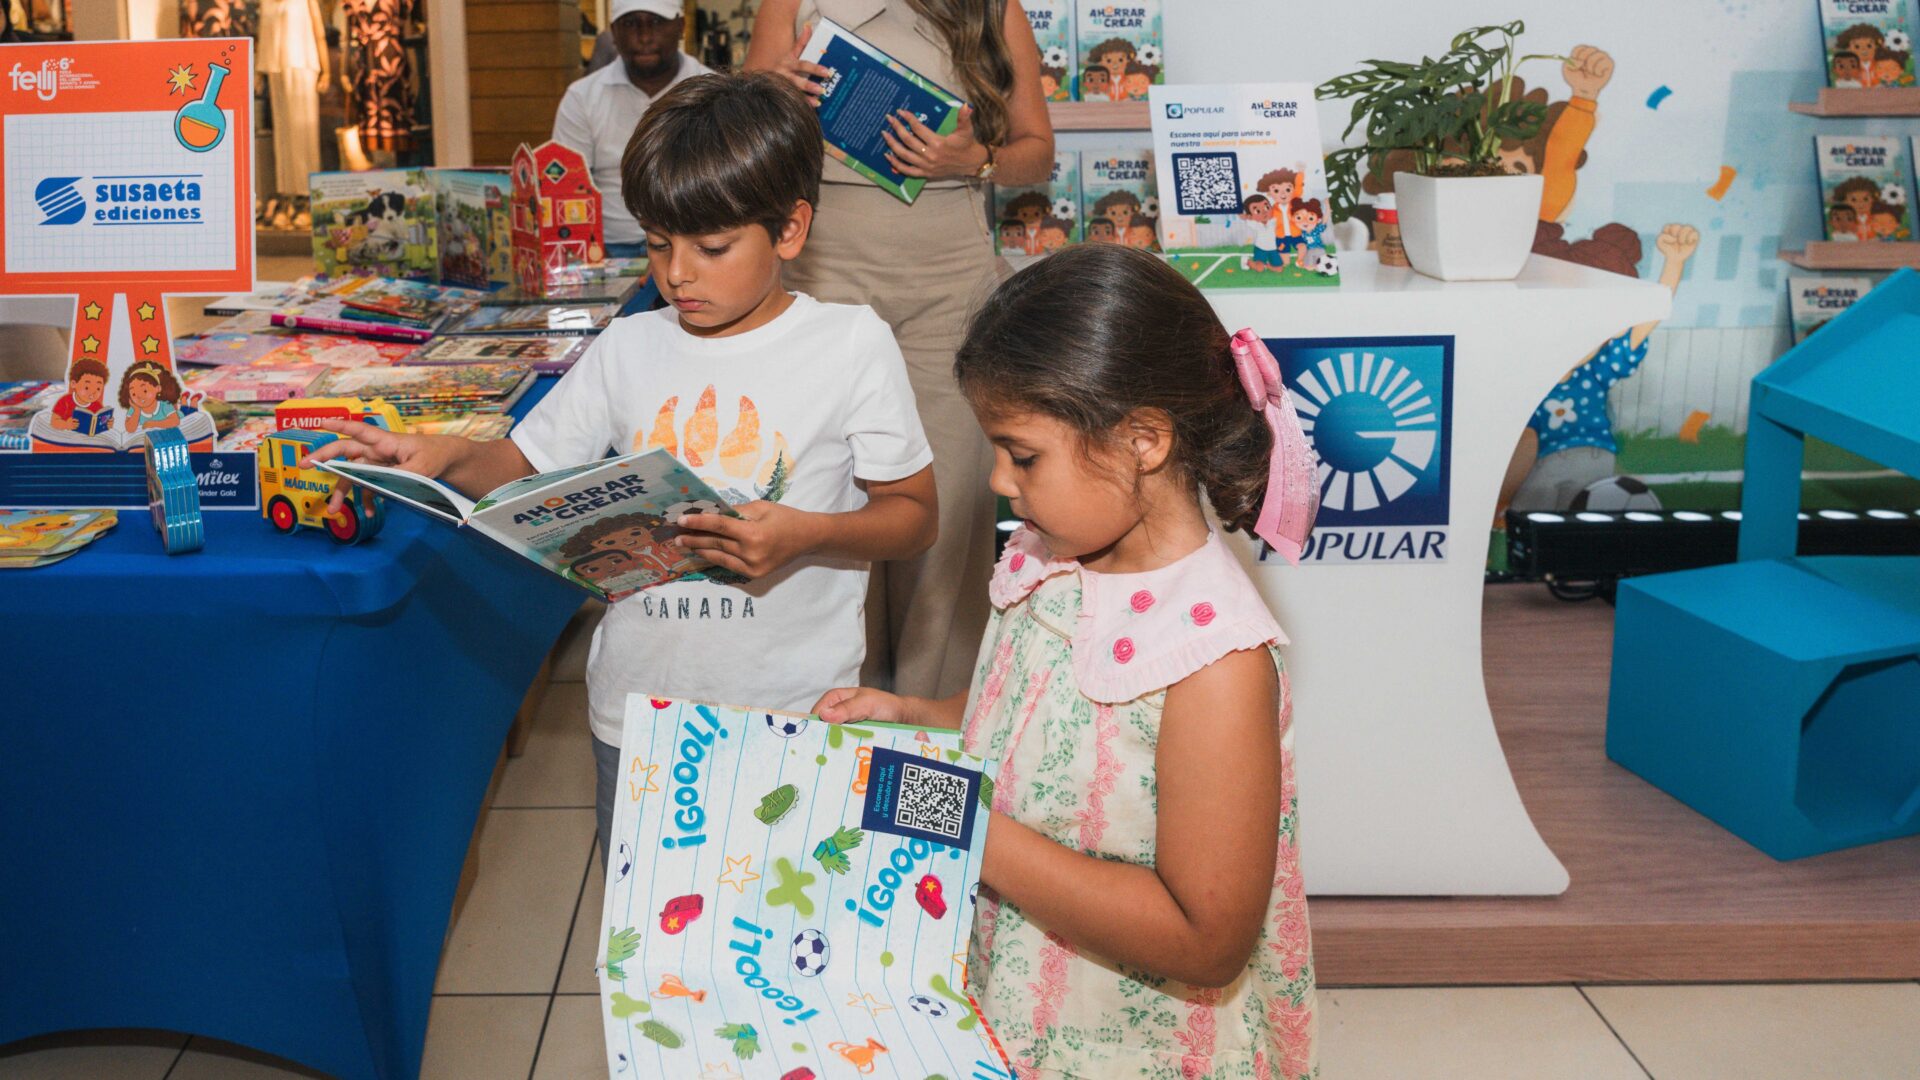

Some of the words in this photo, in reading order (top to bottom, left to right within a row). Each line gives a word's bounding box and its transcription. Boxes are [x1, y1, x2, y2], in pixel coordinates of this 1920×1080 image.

[1089, 5, 1146, 18] AHORRAR
[1848, 4, 1888, 14] CREAR
[1104, 18, 1143, 28] CREAR
[1184, 106, 1225, 114] POPULAR
[1251, 100, 1298, 110] AHORRAR
[1263, 110, 1296, 118] CREAR
[1170, 131, 1201, 139] Escanea
[1203, 130, 1220, 139] aquí
[1221, 131, 1239, 139] para
[1830, 144, 1887, 156] AHORRAR
[1094, 158, 1149, 170] AHORRAR
[1846, 156, 1885, 167] CREAR
[1108, 170, 1146, 180] CREAR
[96, 179, 200, 203] susaeta
[95, 205, 201, 220] ediciones
[1803, 286, 1858, 298] AHORRAR
[282, 416, 345, 429] CAMIO
[196, 471, 240, 486] Milex
[285, 476, 330, 494] MÁQUINAS
[220, 489, 237, 497] Gold
[513, 474, 646, 525] AHORRAR
[530, 514, 554, 527] ES
[556, 485, 649, 520] CREAR
[1259, 531, 1447, 561] PULAR
[643, 596, 755, 620] CANADA
[873, 783, 884, 812] Escanea
[882, 780, 893, 812] descubre
